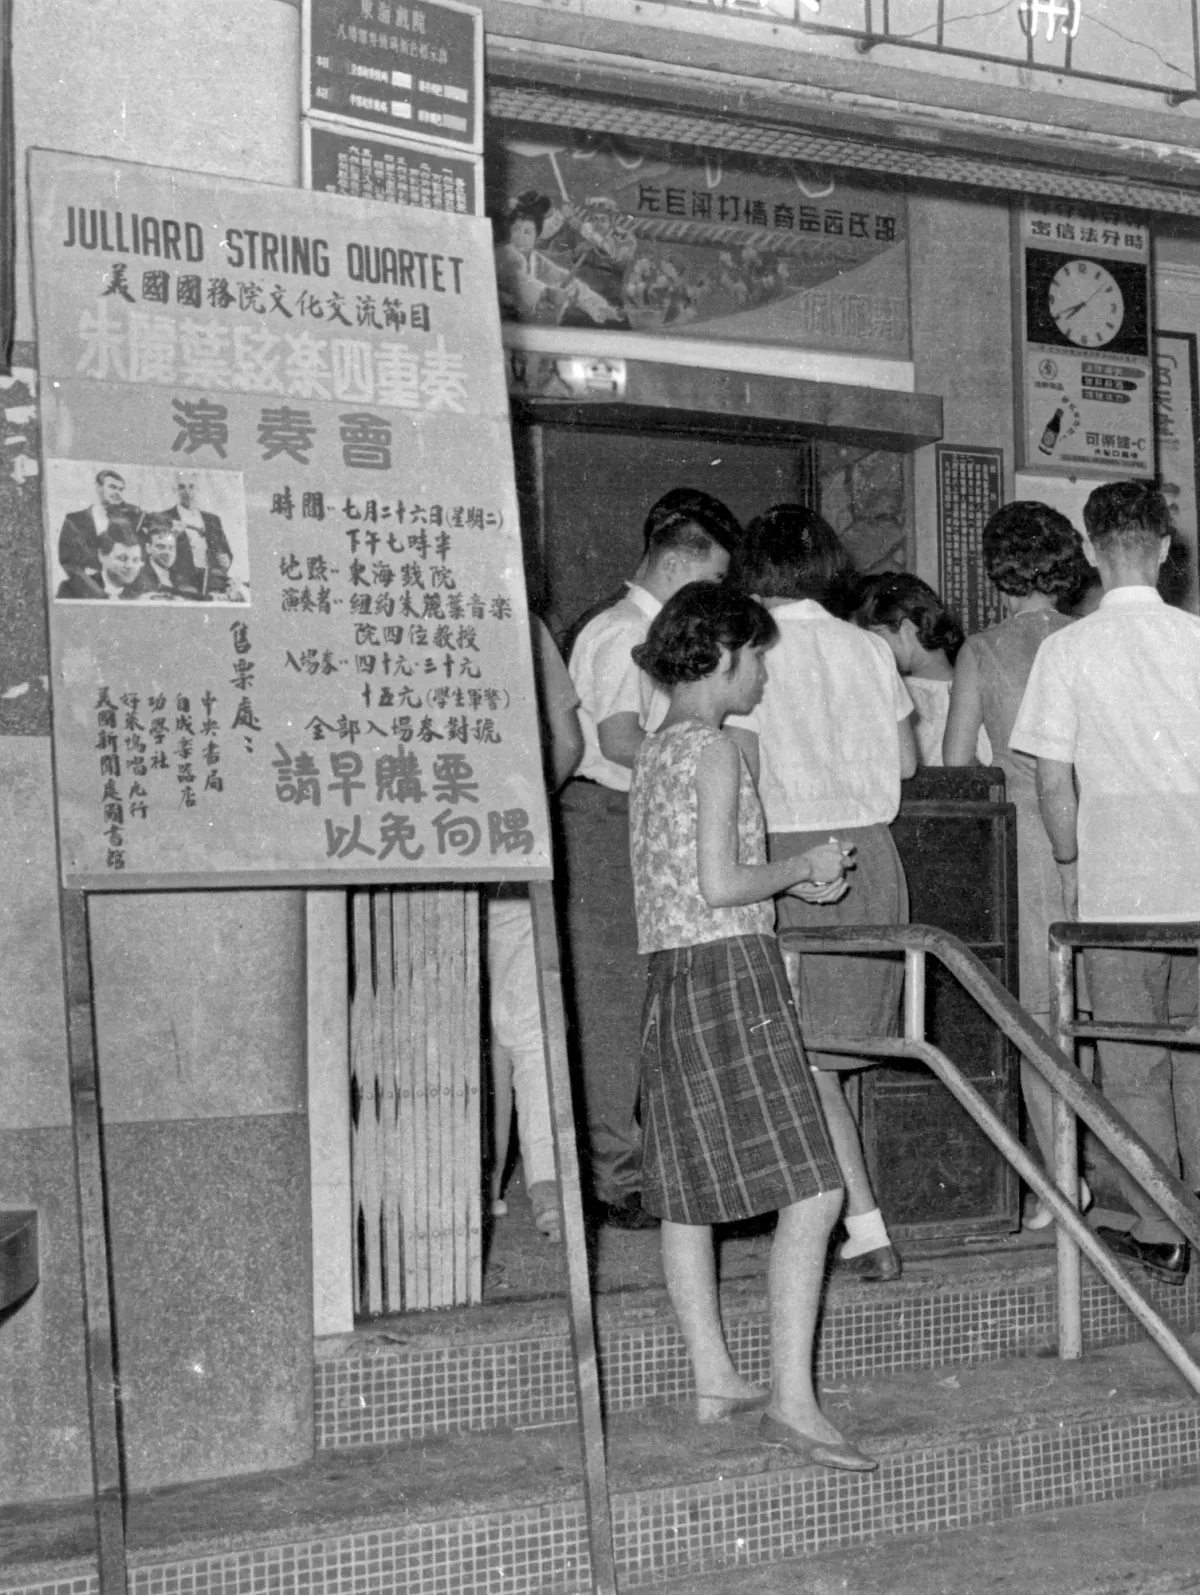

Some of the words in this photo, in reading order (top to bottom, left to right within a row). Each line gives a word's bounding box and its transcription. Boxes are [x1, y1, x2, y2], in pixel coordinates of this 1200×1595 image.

[63, 206, 204, 263] JULLIARD
[226, 228, 330, 277] STRING
[347, 242, 464, 294] QUARTET
[101, 262, 431, 333] 美國國務院文化交流節目
[171, 398, 393, 470] 演奏會
[345, 527, 452, 563] 下午七時半
[354, 621, 481, 652] 院四位教授
[200, 689, 224, 793] 中央書局
[271, 741, 480, 807] 請早購票
[324, 806, 535, 862] 以免向隅
